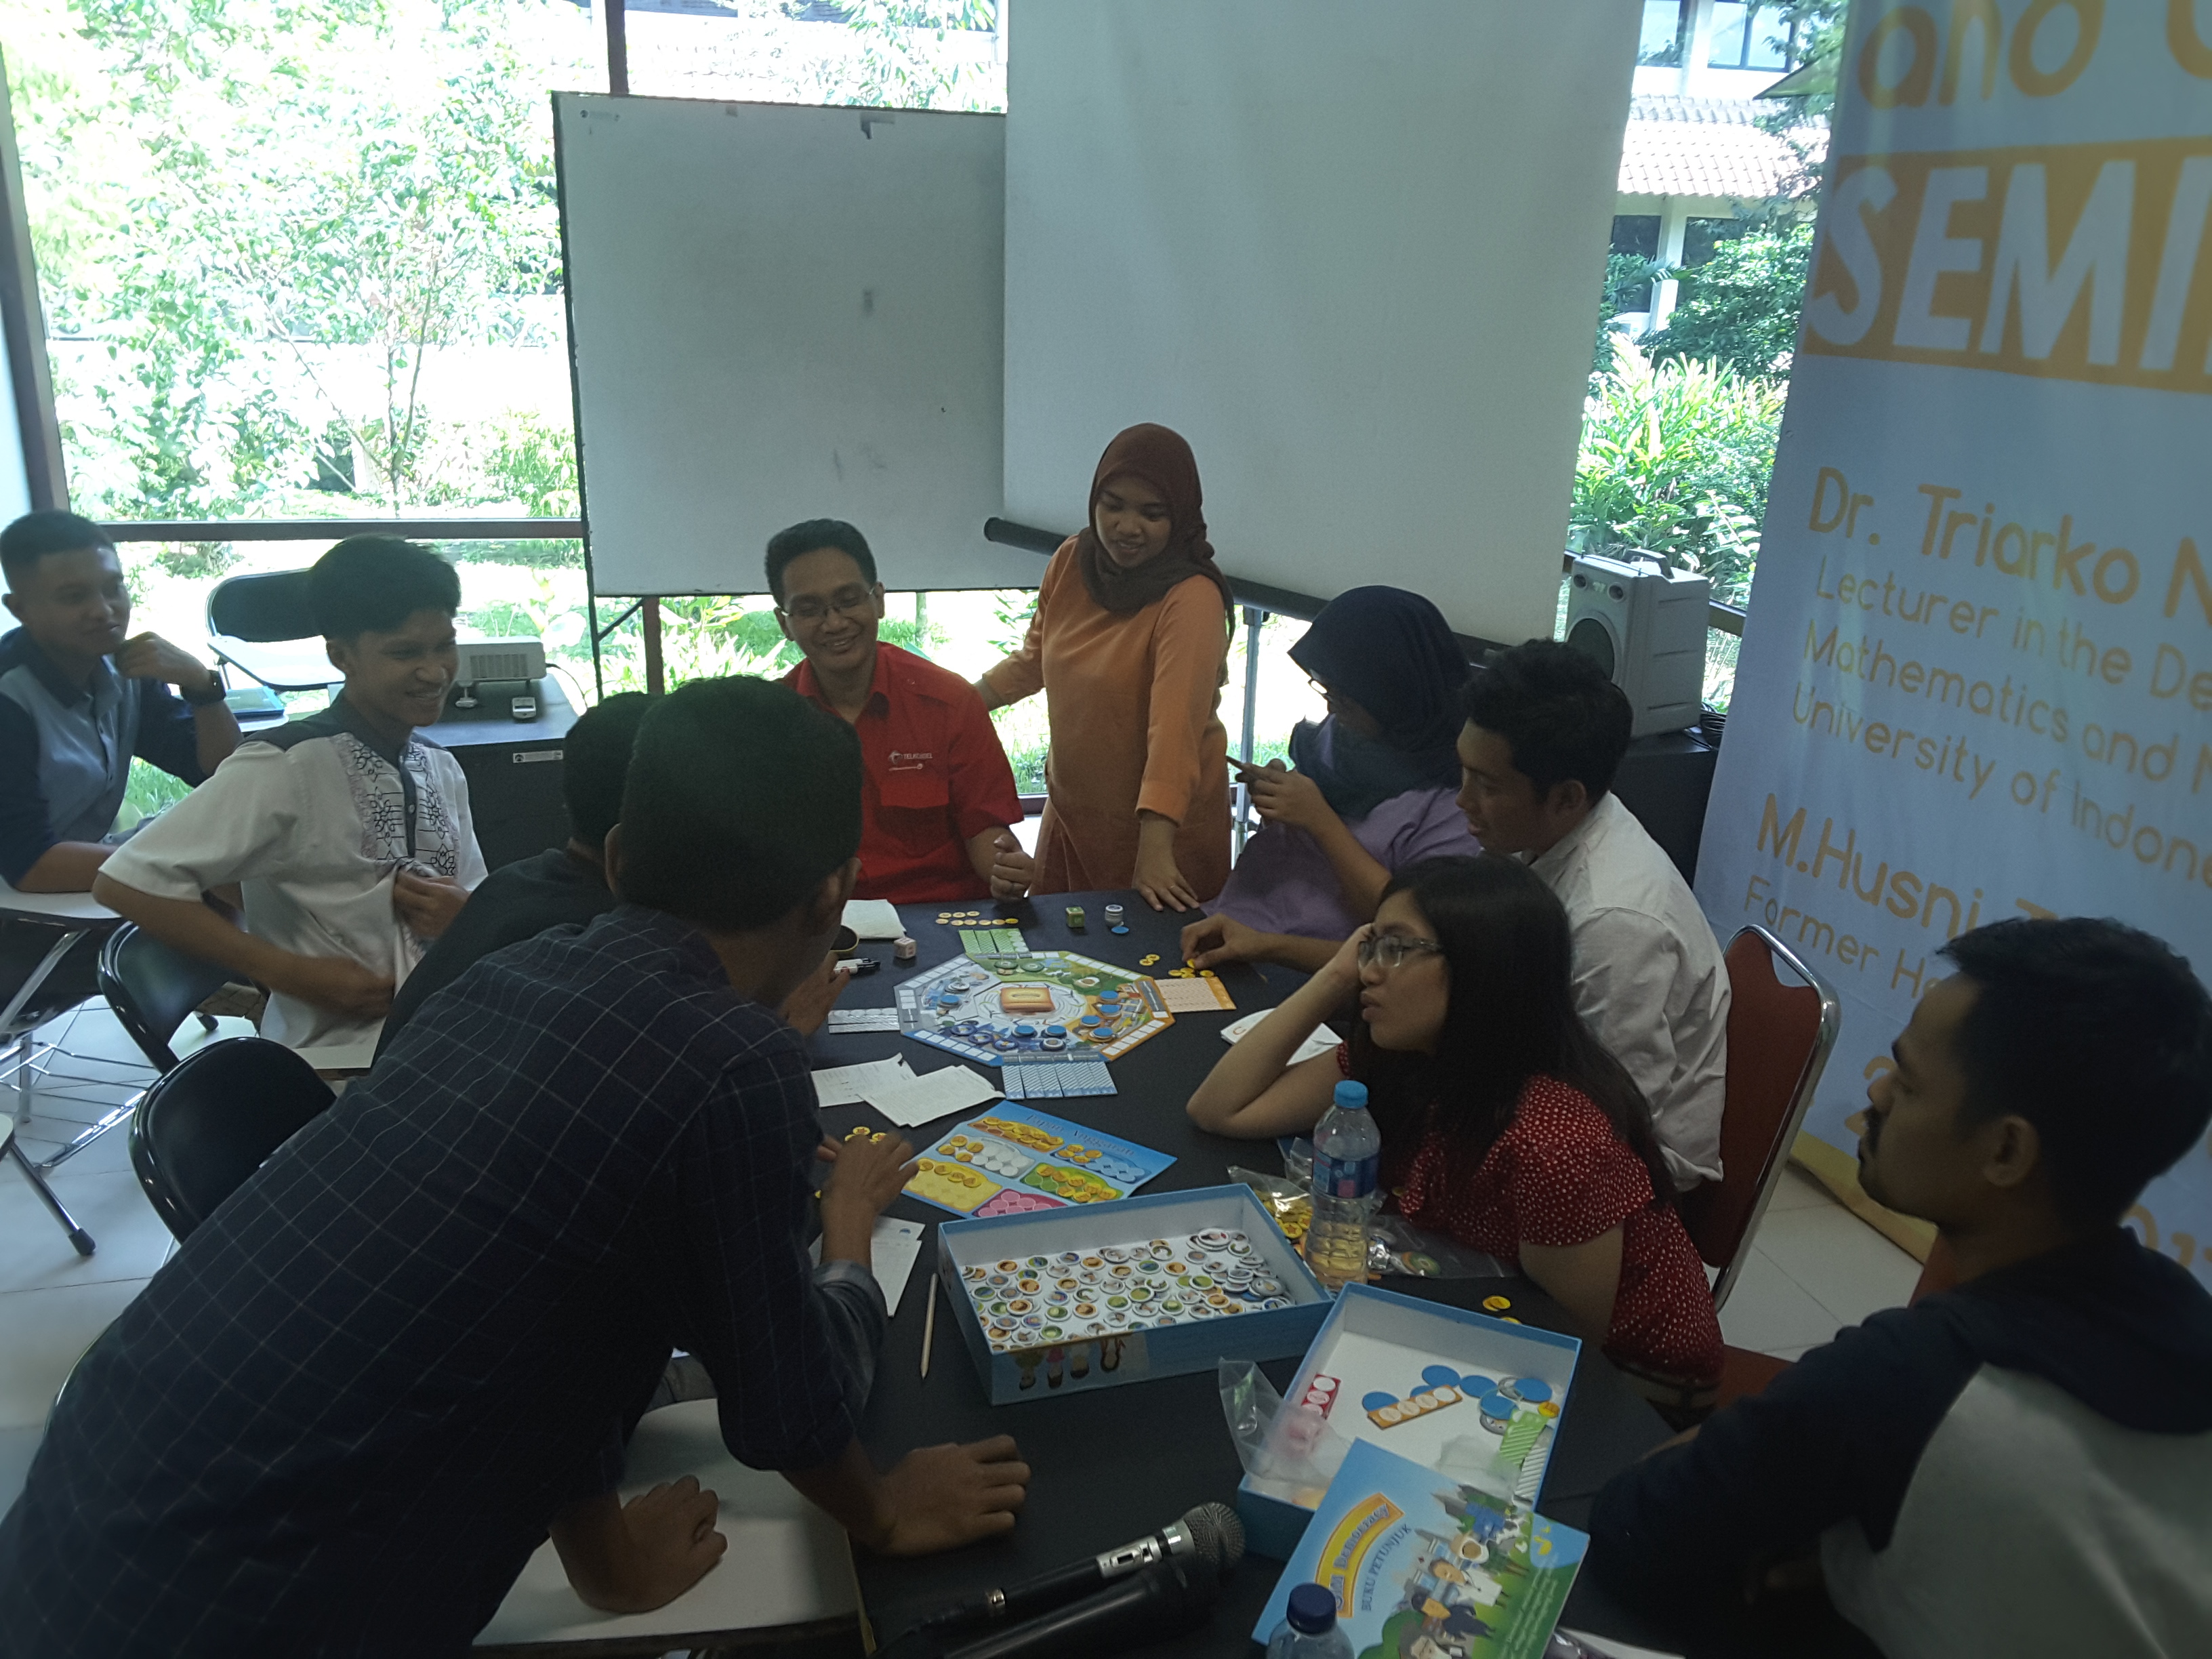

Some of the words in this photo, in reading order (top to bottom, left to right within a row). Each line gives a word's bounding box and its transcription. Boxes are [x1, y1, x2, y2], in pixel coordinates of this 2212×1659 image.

[1805, 156, 2212, 375] SEMI
[1808, 466, 1881, 546] Dr.
[1917, 483, 2141, 605] Triarko
[1817, 554, 1999, 638] Lecturer
[2013, 606, 2046, 657] in
[2058, 617, 2133, 686] the
[1793, 680, 1996, 800] University
[2011, 768, 2062, 814] of
[1803, 617, 2069, 743] Mathematics
[2083, 722, 2179, 781] and
[1744, 874, 1879, 972] Former
